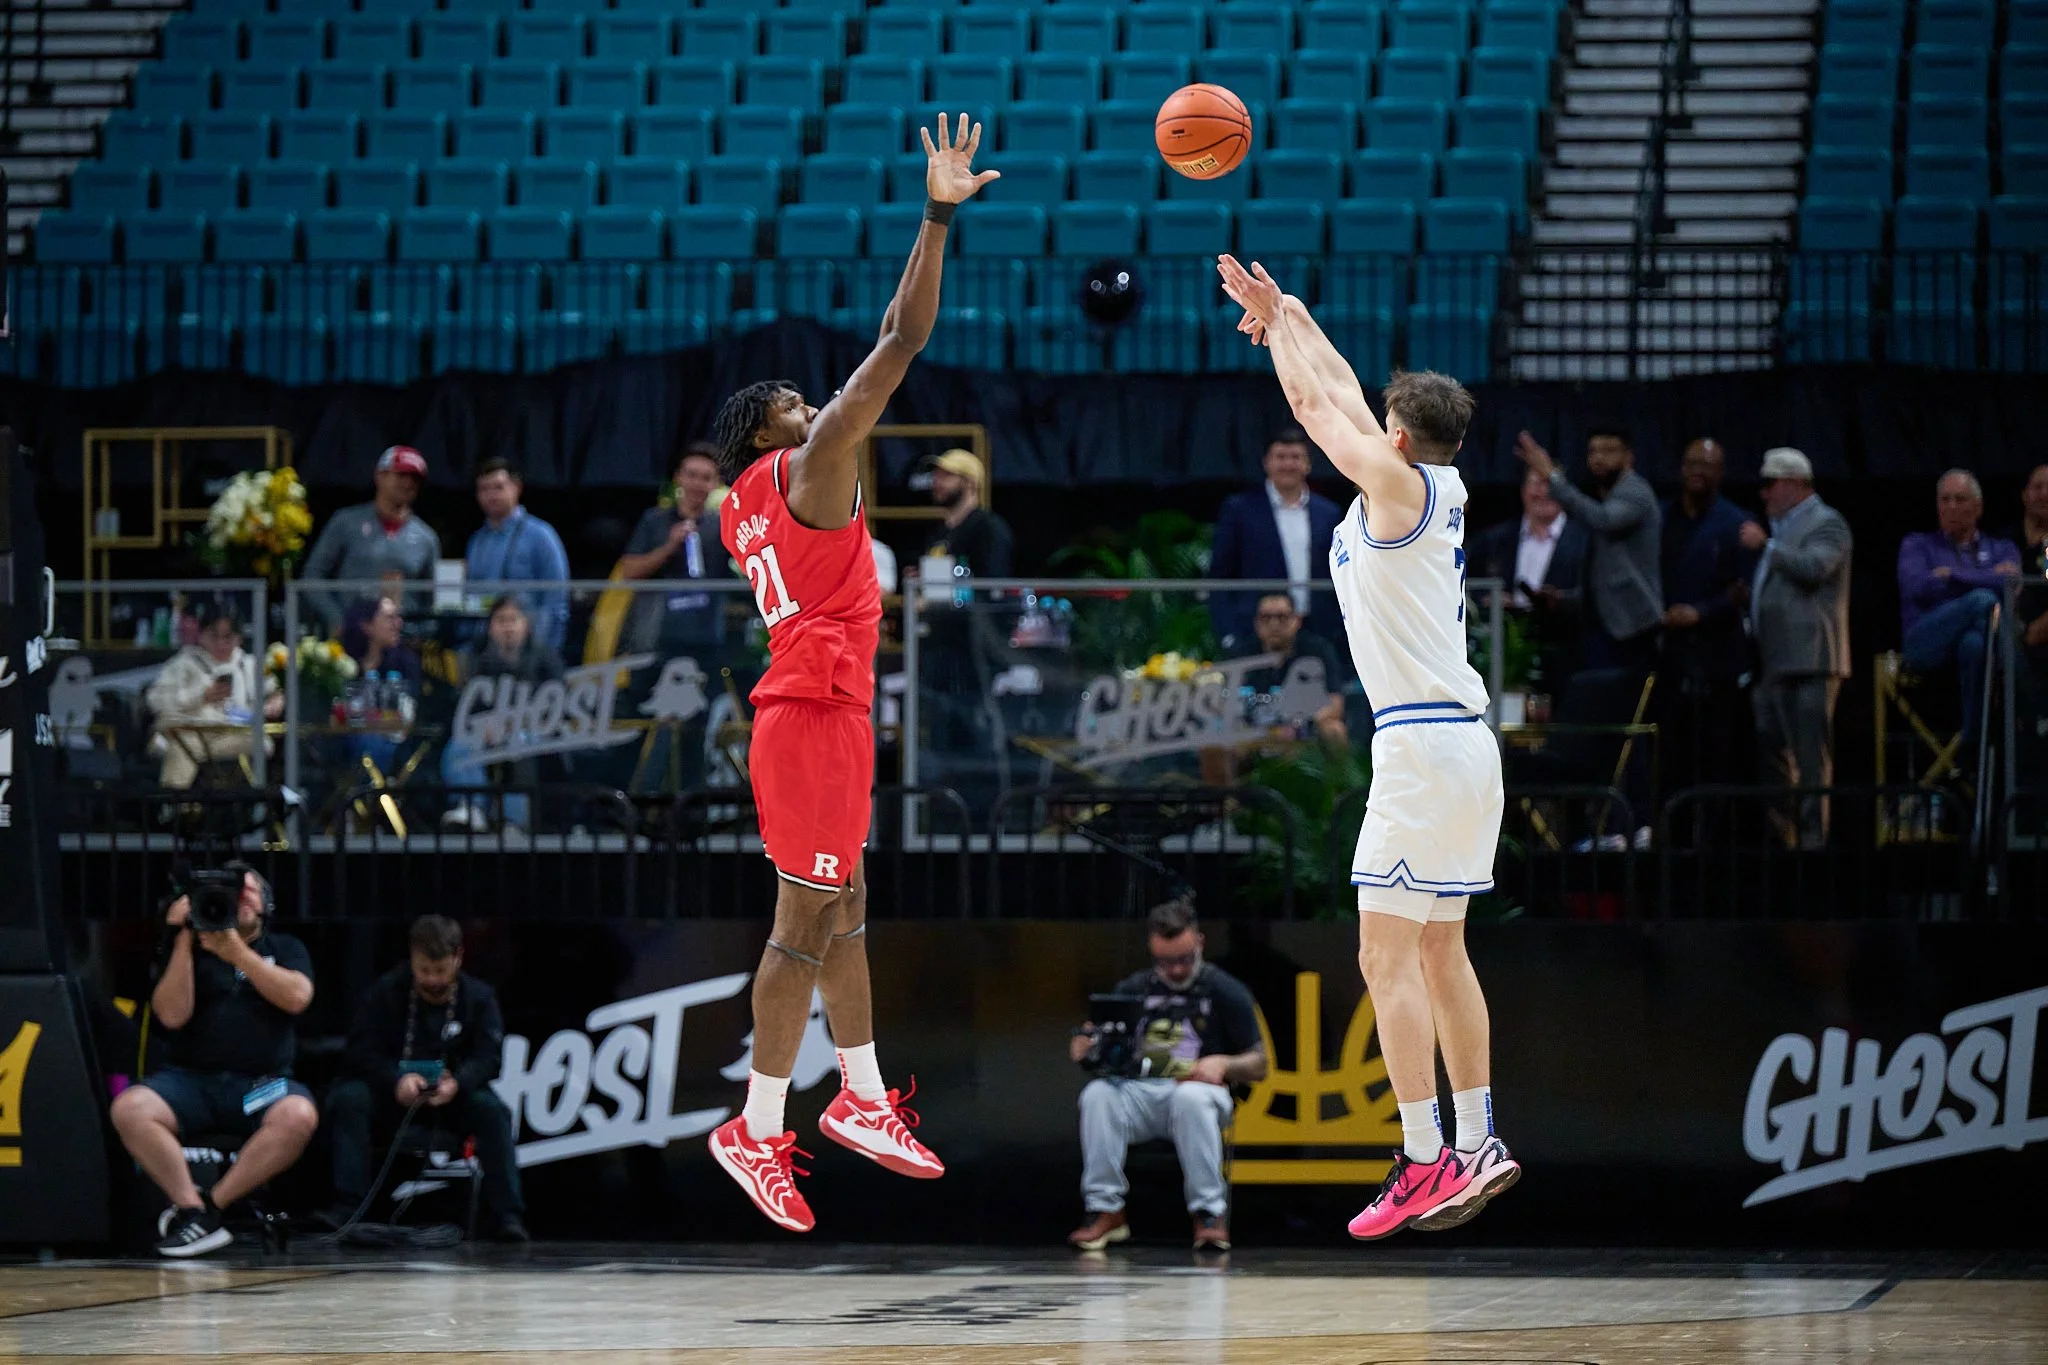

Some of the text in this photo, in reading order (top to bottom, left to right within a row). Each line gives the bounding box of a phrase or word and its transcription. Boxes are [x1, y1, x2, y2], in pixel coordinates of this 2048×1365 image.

[746, 545, 800, 628] 21
[452, 652, 656, 766] GHOST
[1075, 652, 1284, 768] GHOST
[811, 852, 839, 879] R
[488, 971, 750, 1168] OST
[1742, 985, 2048, 1208] GHOST
